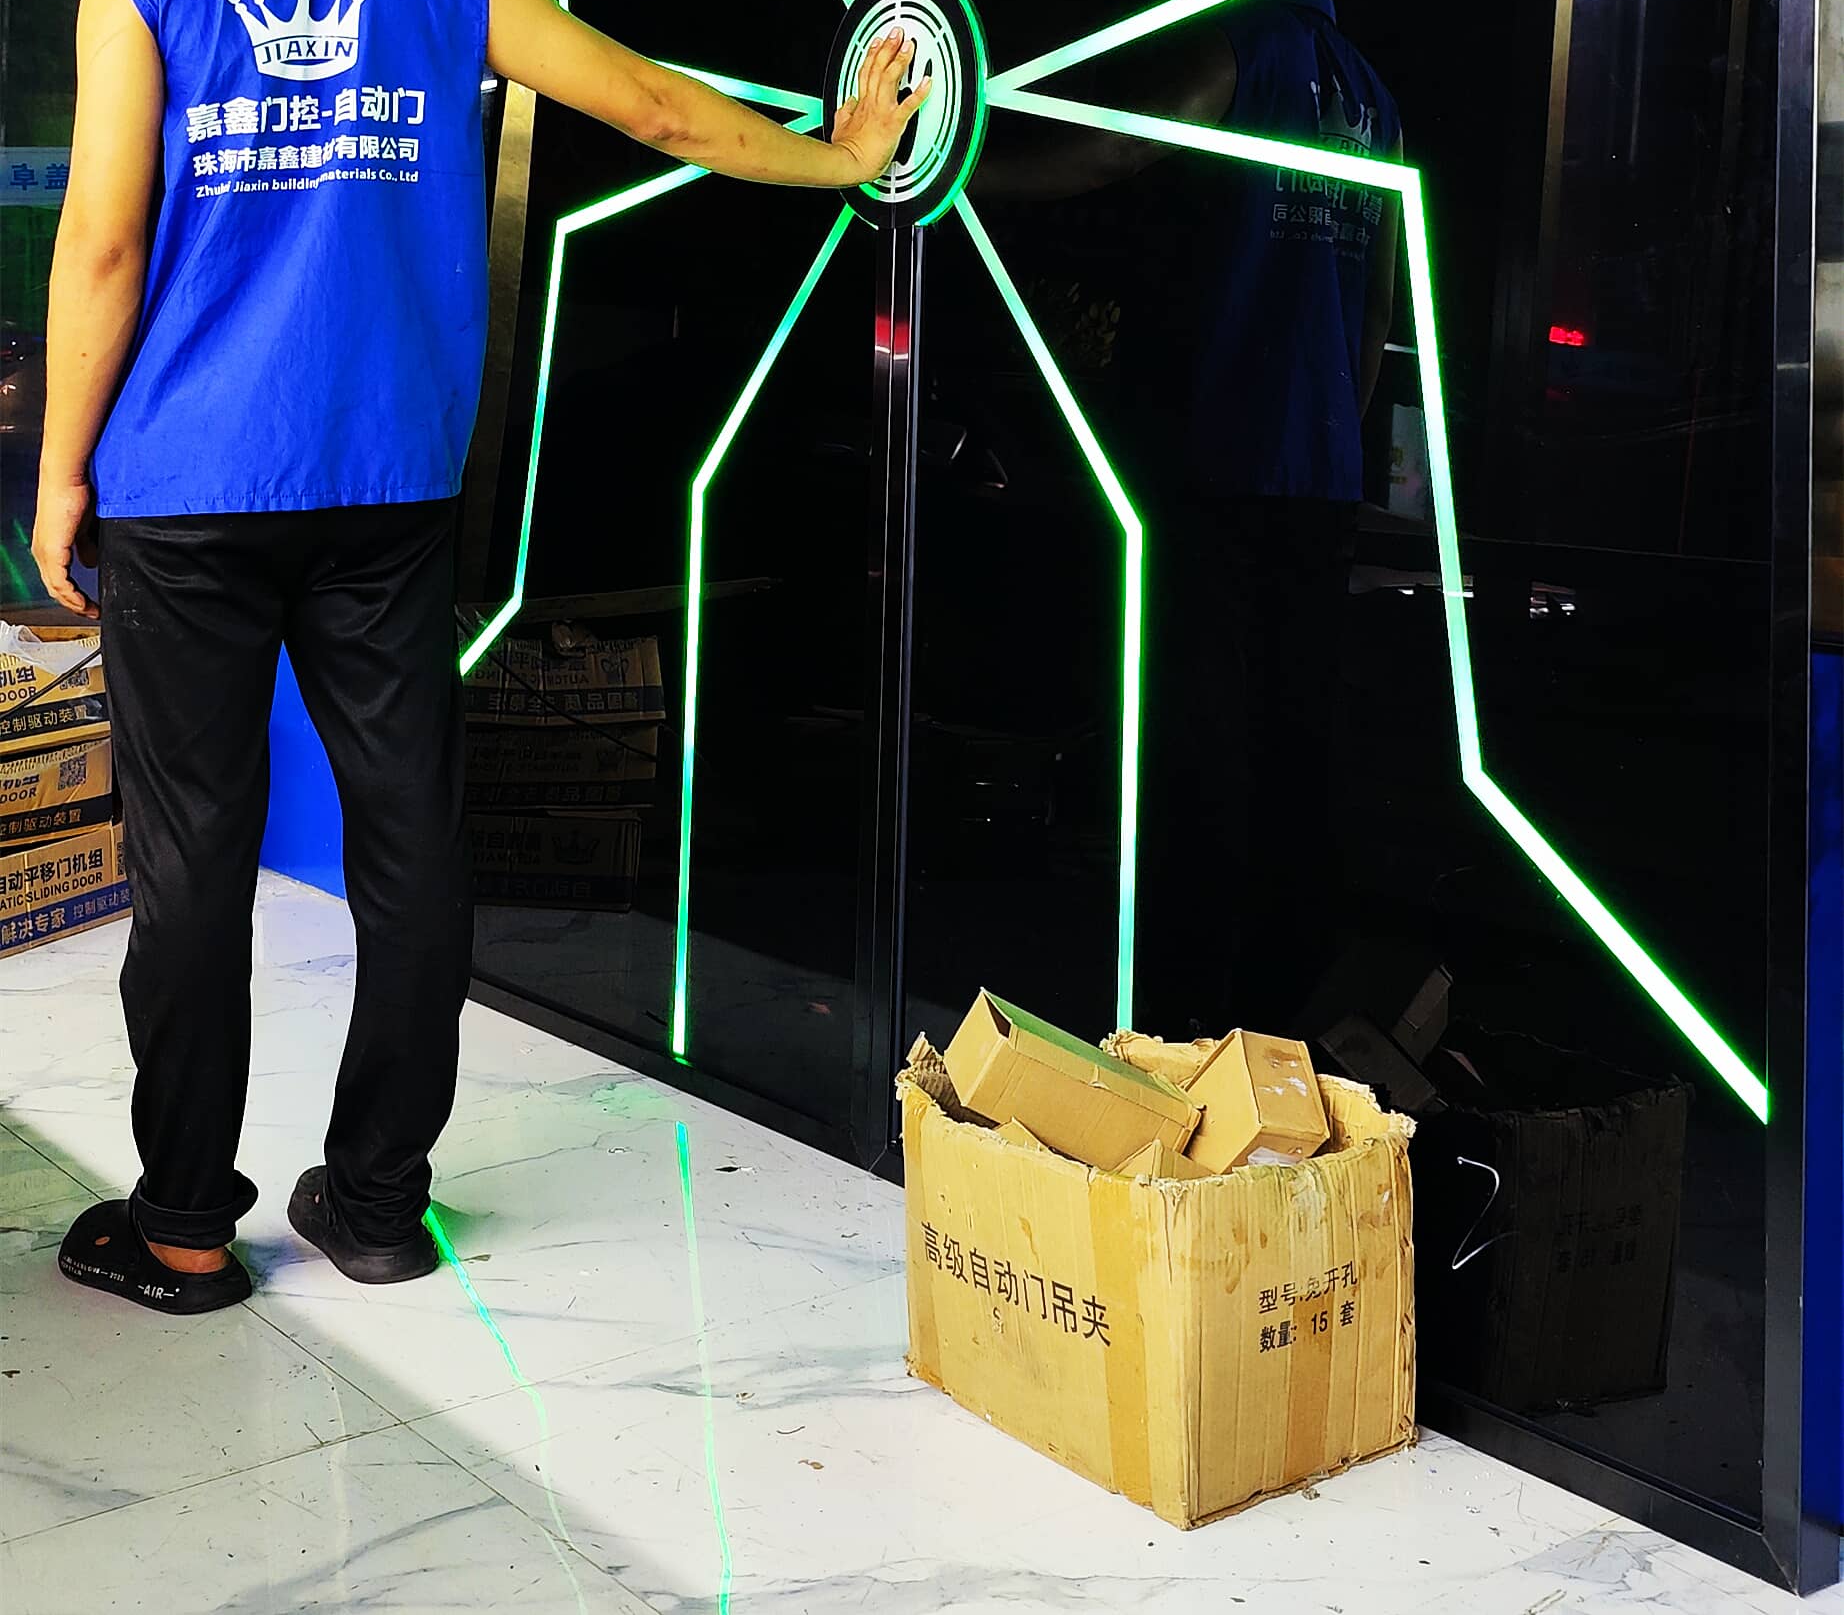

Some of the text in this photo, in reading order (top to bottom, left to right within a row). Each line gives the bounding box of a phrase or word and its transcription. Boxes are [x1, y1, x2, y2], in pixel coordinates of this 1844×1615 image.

[261, 40, 354, 65] JIAXIN
[185, 85, 426, 143] 嘉鑫门控-自动门
[233, 178, 269, 194] Jiaxin
[399, 169, 419, 184] Ltd
[26, 881, 70, 903] SLIDING
[72, 871, 103, 891] DOOR
[921, 1221, 1111, 1347] 高级自动门吊夹
[1311, 1310, 1328, 1335] 15
[1340, 1300, 1355, 1327] 套
